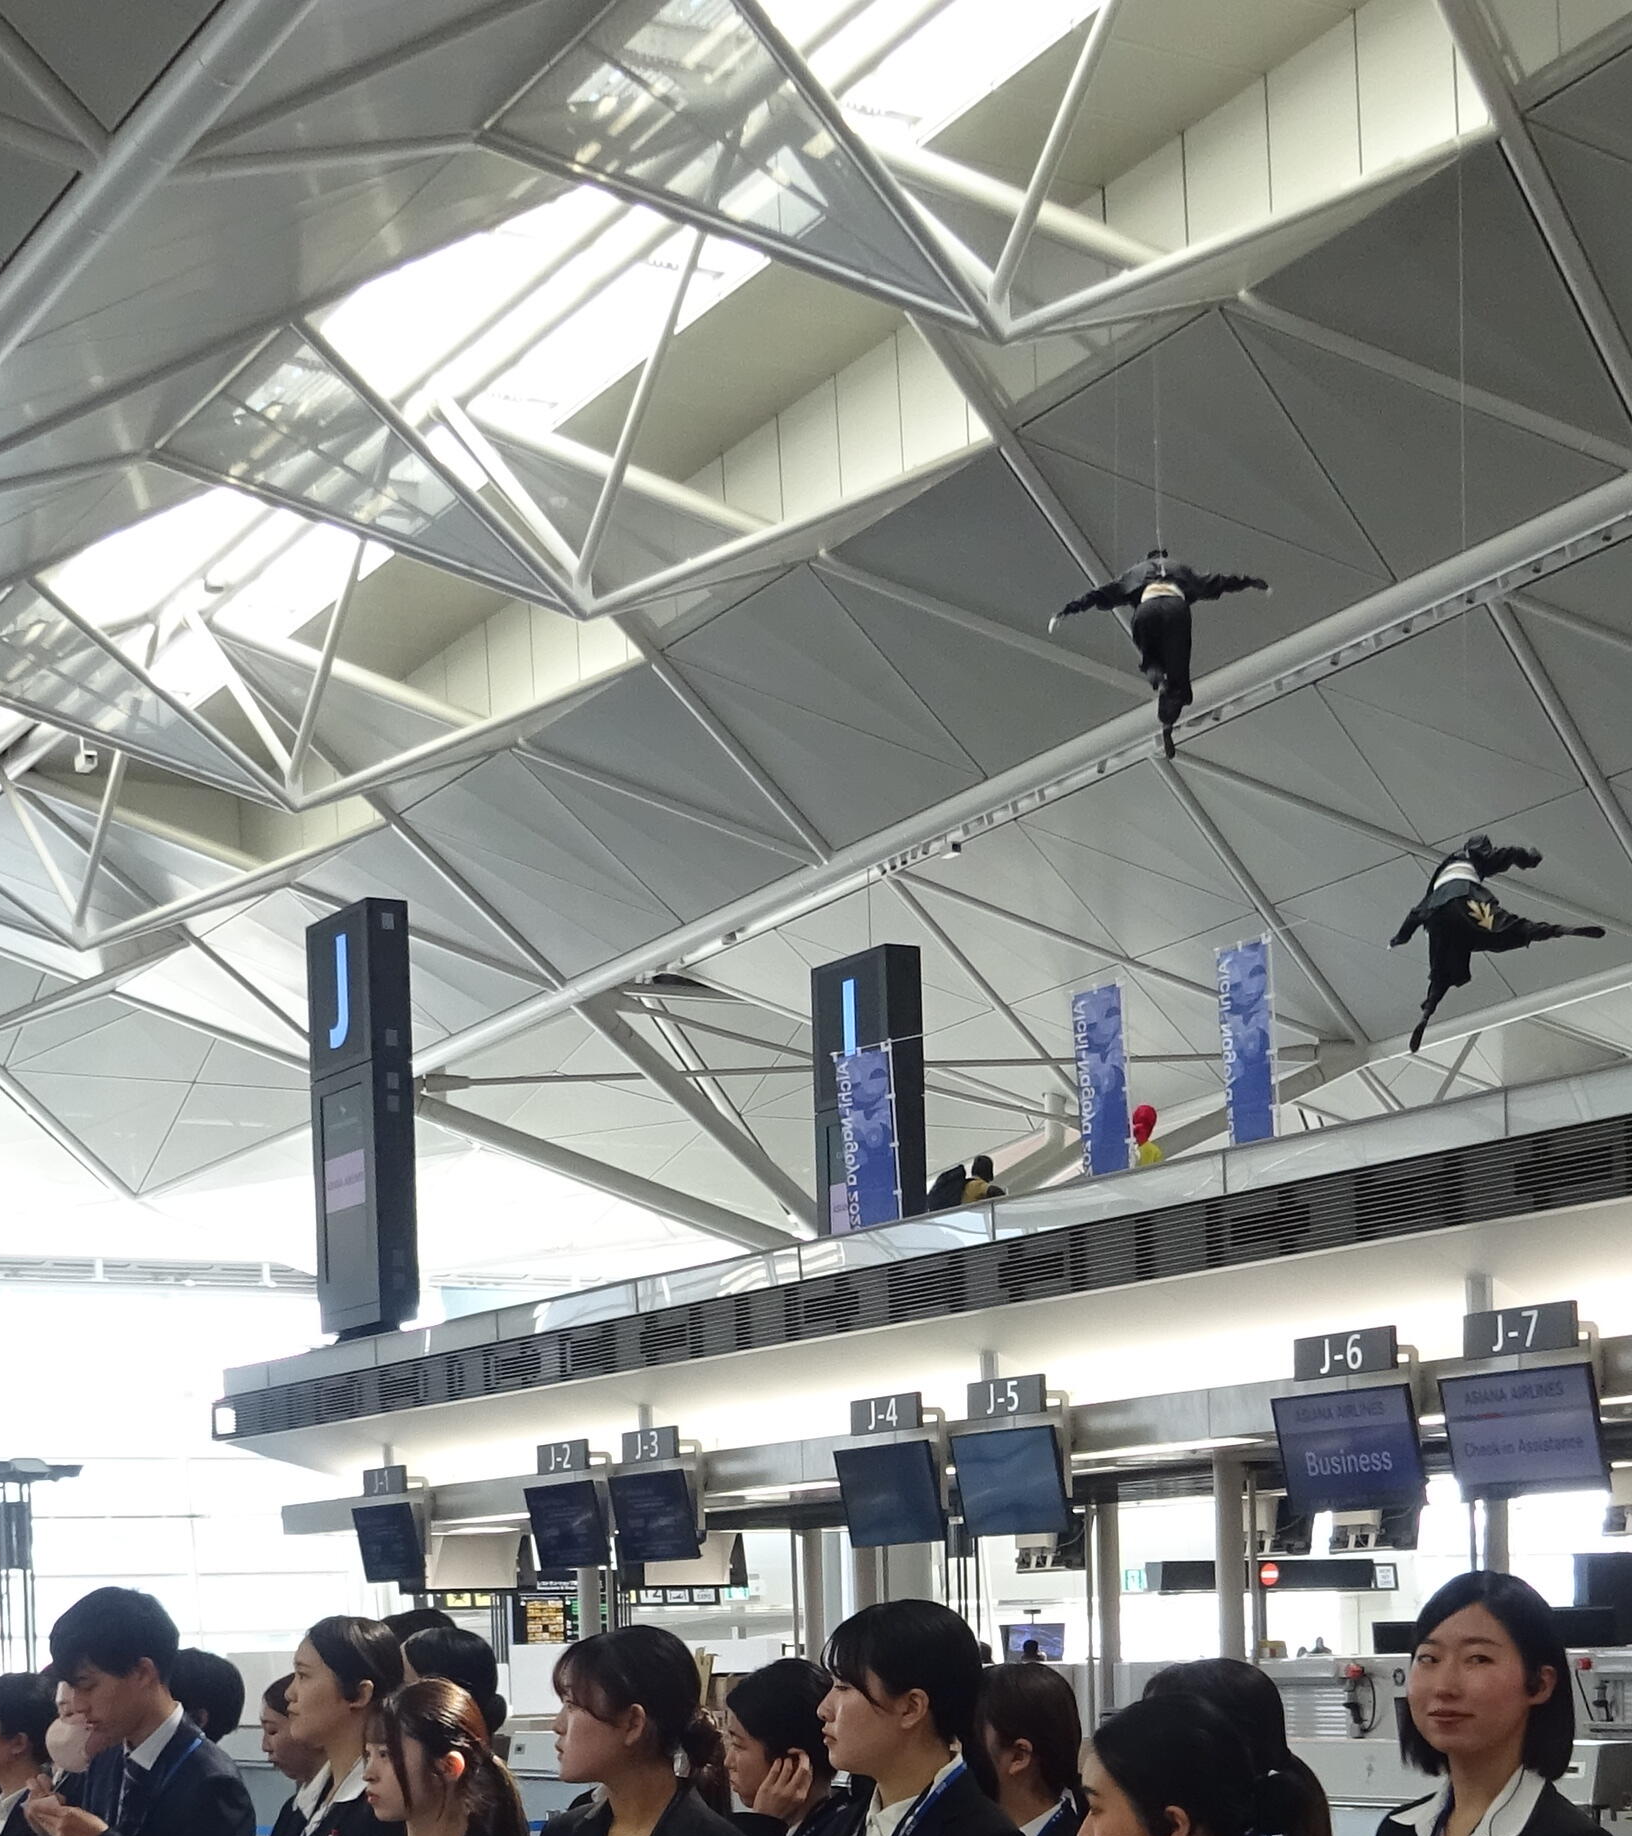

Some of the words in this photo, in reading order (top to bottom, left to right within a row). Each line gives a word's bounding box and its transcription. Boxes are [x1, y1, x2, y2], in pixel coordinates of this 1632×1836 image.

[329, 933, 350, 1049] J
[1491, 1309, 1539, 1353] J-7
[1319, 1334, 1364, 1375] J-6
[867, 1397, 898, 1431] J-4
[986, 1380, 1019, 1415] J-5
[549, 1446, 572, 1471] J-2
[635, 1434, 660, 1459] J-3
[1304, 1449, 1394, 1478] Business
[372, 1470, 390, 1494] J-1
